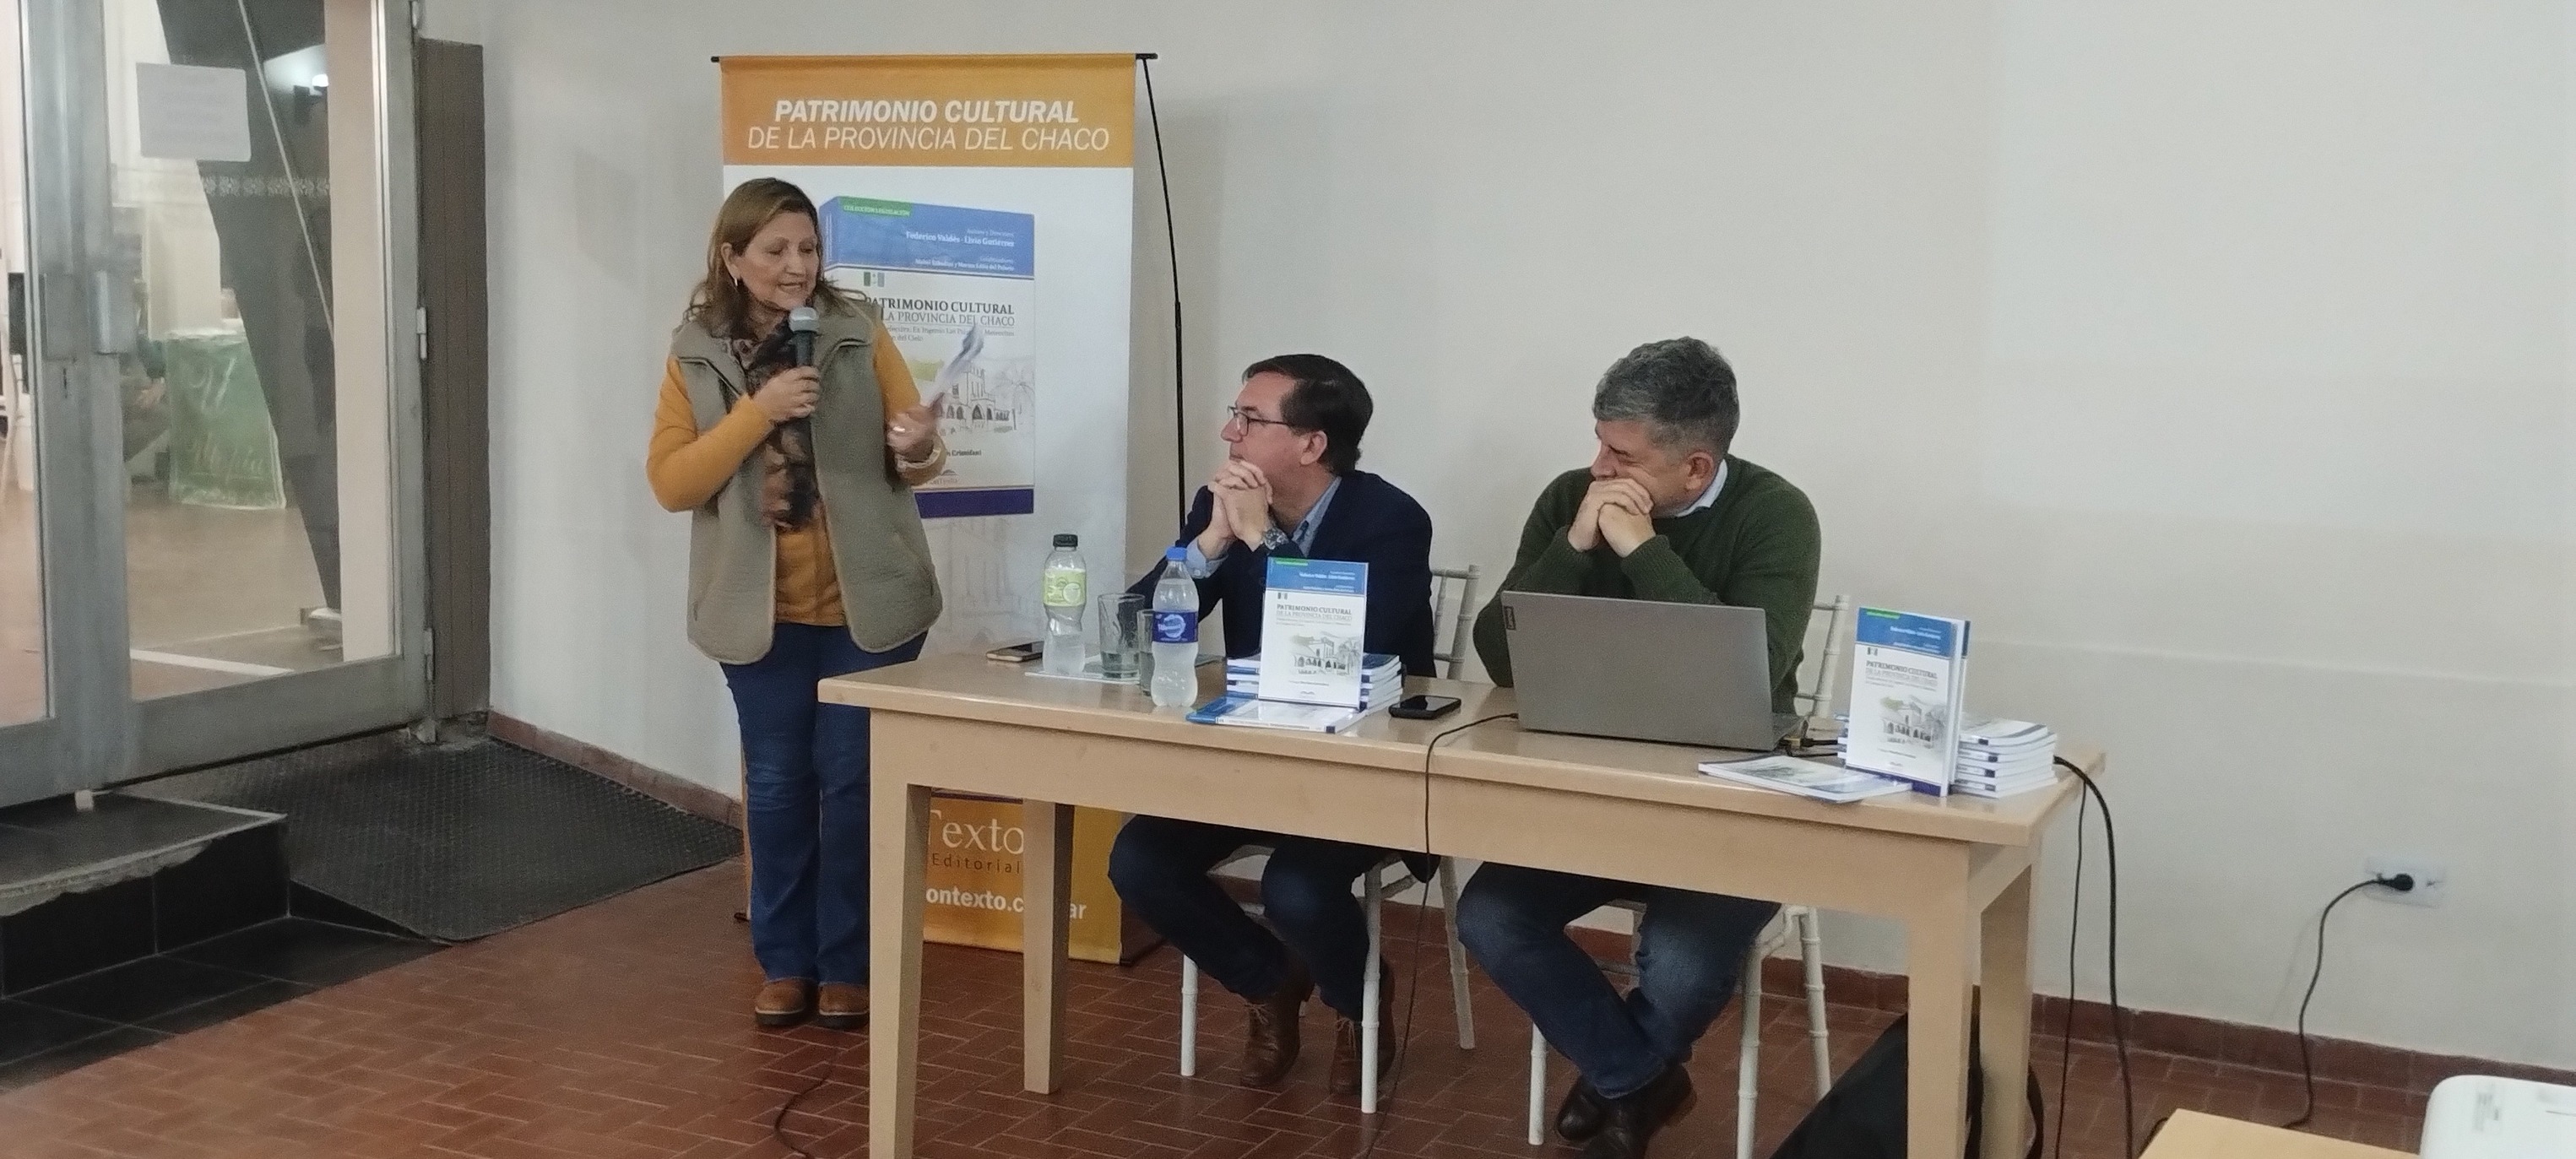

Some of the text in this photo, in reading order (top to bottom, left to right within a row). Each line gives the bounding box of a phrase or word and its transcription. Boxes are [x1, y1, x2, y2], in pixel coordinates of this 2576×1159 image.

[774, 99, 1080, 124] PATRIMONIO CULTURAL
[747, 125, 1109, 151] DE LA PROVINCIA DEL CHACO
[905, 230, 936, 241] Federico
[952, 301, 1015, 315] CULTURAL
[898, 311, 957, 324] PROVINCIA
[980, 315, 1015, 327] CHACO
[932, 852, 1020, 875] Editorial
